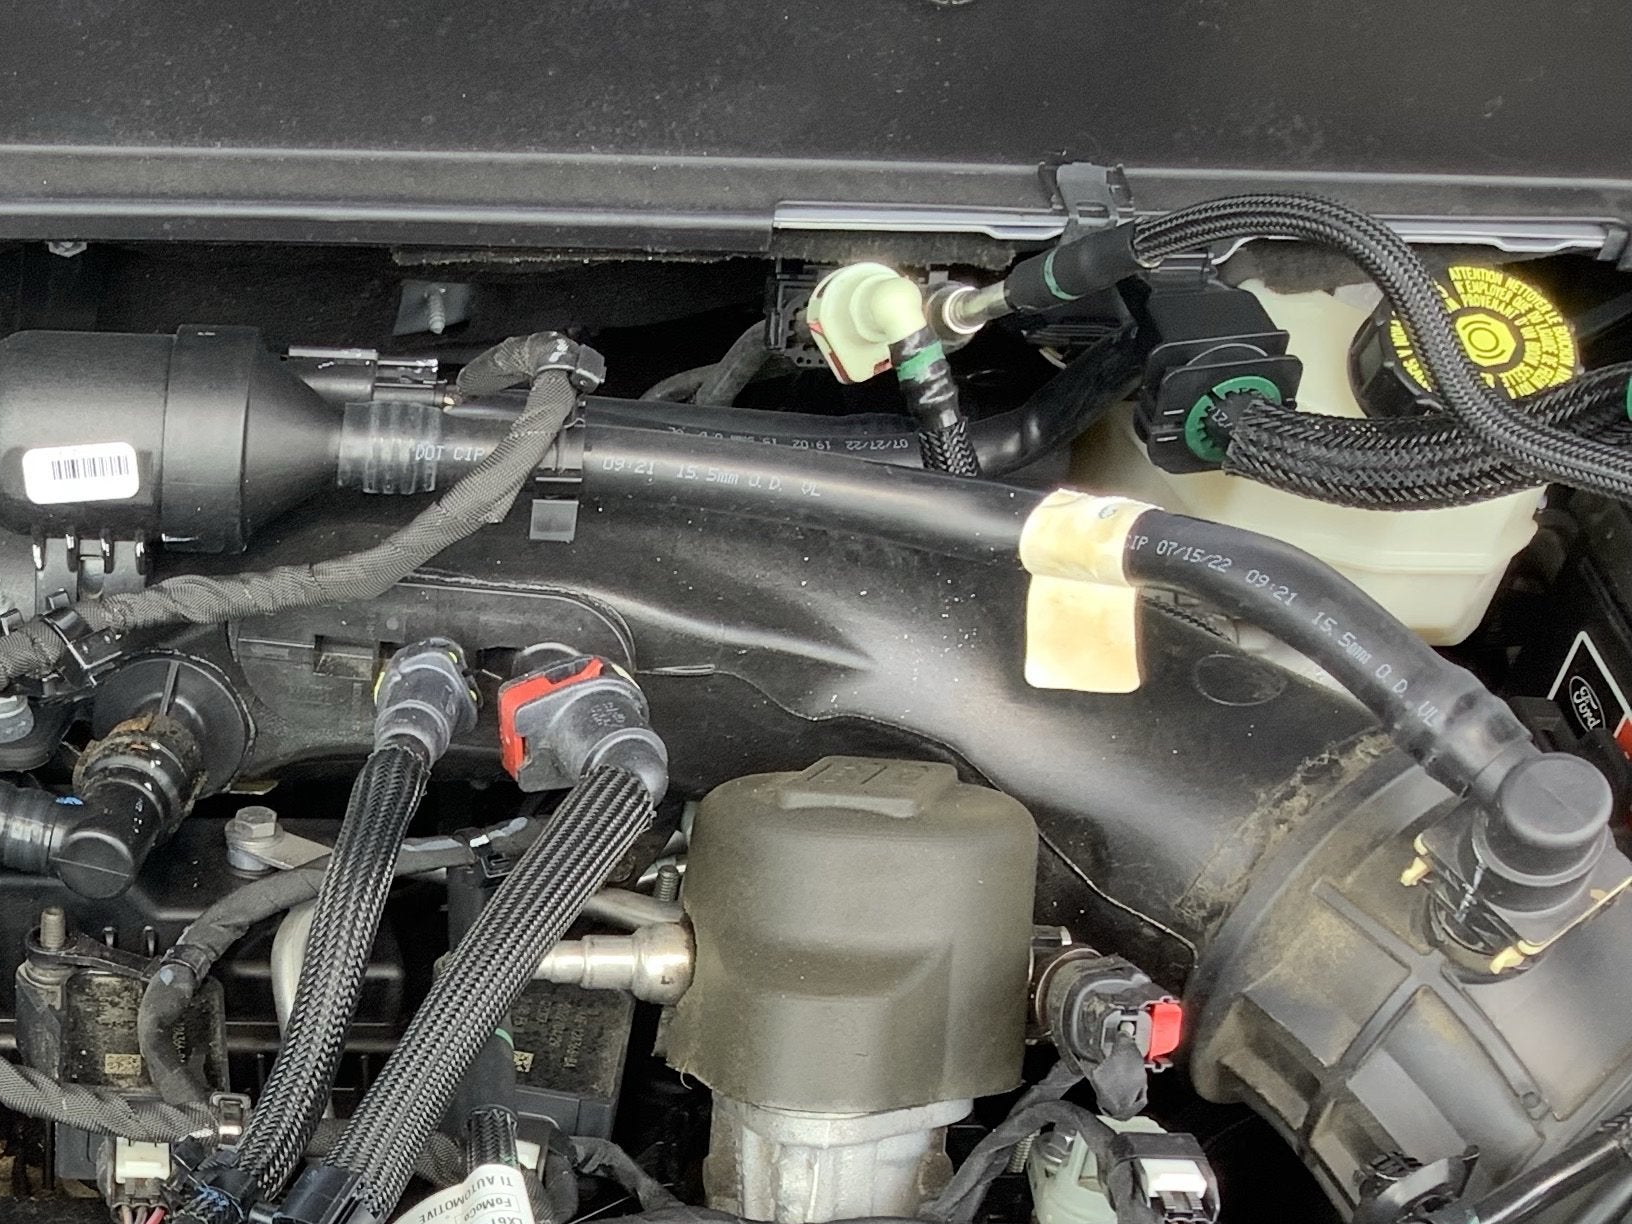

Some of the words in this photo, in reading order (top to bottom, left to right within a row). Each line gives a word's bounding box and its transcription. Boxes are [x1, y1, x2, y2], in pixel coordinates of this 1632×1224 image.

[1449, 266, 1503, 285] ATTENTION
[1505, 277, 1552, 313] NETTOYER
[1545, 311, 1563, 324] LE
[1512, 296, 1532, 313] QUE
[415, 445, 444, 461] DOT
[602, 458, 654, 475] 09:21
[1156, 540, 1232, 573] 07/15/22
[1245, 569, 1298, 606] 09:21
[1572, 685, 1601, 729] Ford
[501, 1175, 514, 1187] TI
[464, 1197, 512, 1222] FoMoCo
